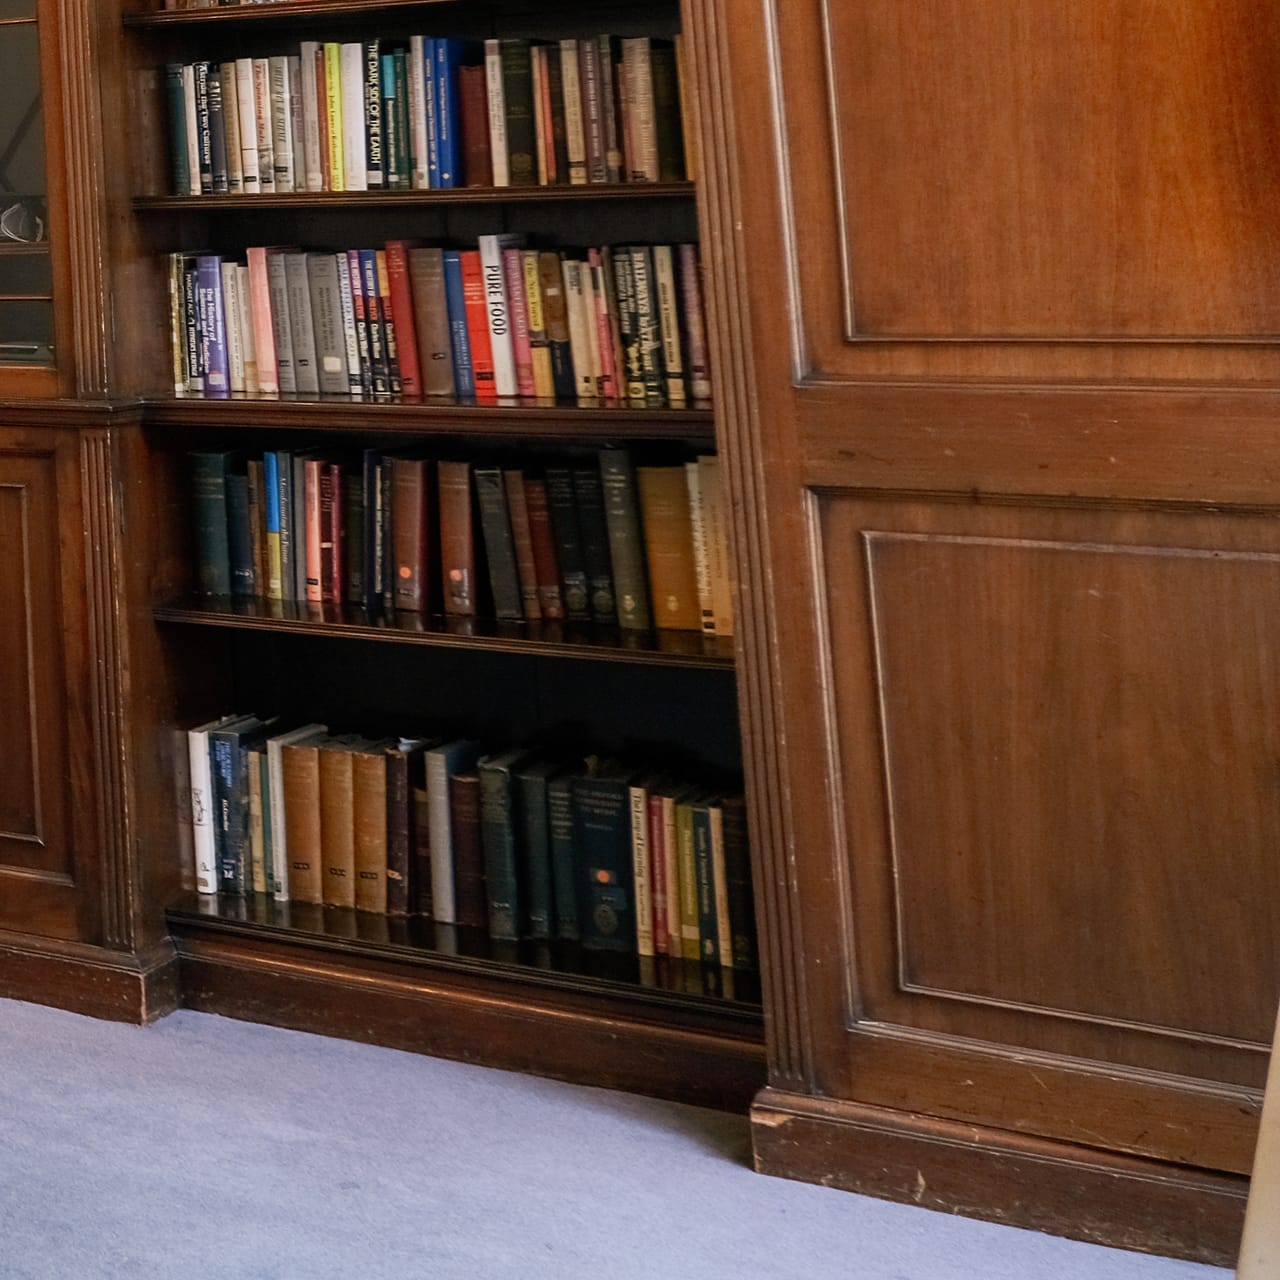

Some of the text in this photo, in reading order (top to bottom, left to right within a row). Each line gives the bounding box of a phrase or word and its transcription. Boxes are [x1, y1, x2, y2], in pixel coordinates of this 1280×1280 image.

[368, 45, 380, 163] THE DARK SIDE OF THE EARTH
[352, 269, 360, 288] HISTORY
[366, 270, 374, 289] HISTORY
[526, 263, 535, 277] The
[634, 253, 649, 313] RAILWAYS
[200, 289, 208, 319] Science
[206, 288, 217, 341] the History of
[486, 265, 506, 335] PURE FOOD
[358, 322, 366, 340] Charles
[371, 324, 379, 342] Charles
[386, 323, 394, 341] Charles
[202, 337, 210, 373] Medicine
[633, 794, 644, 878] The Lamp of Learning
